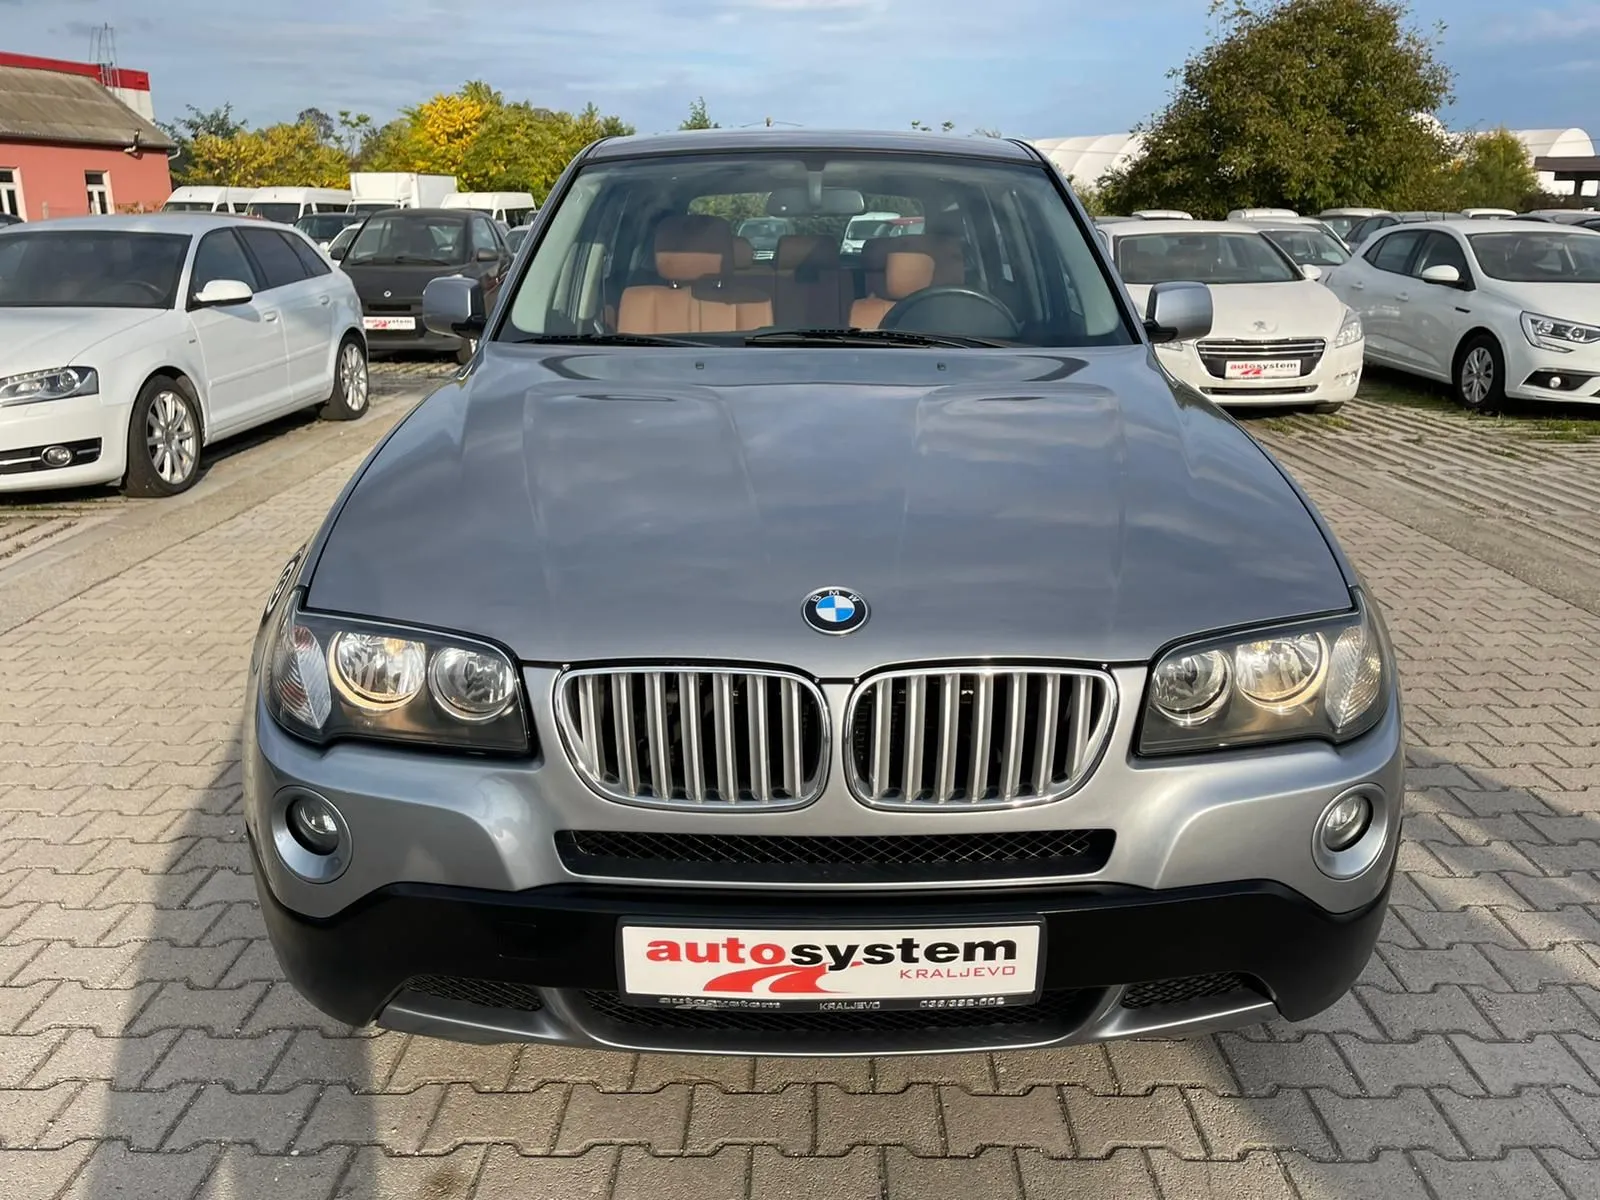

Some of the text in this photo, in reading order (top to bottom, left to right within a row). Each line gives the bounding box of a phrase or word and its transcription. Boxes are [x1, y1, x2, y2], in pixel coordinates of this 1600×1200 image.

[1230, 362, 1297, 370] autosystem
[811, 590, 859, 602] BMW
[646, 937, 1018, 971] autosystem
[899, 966, 1017, 979] KRALJEVO
[819, 1001, 880, 1010] KRALJEVO
